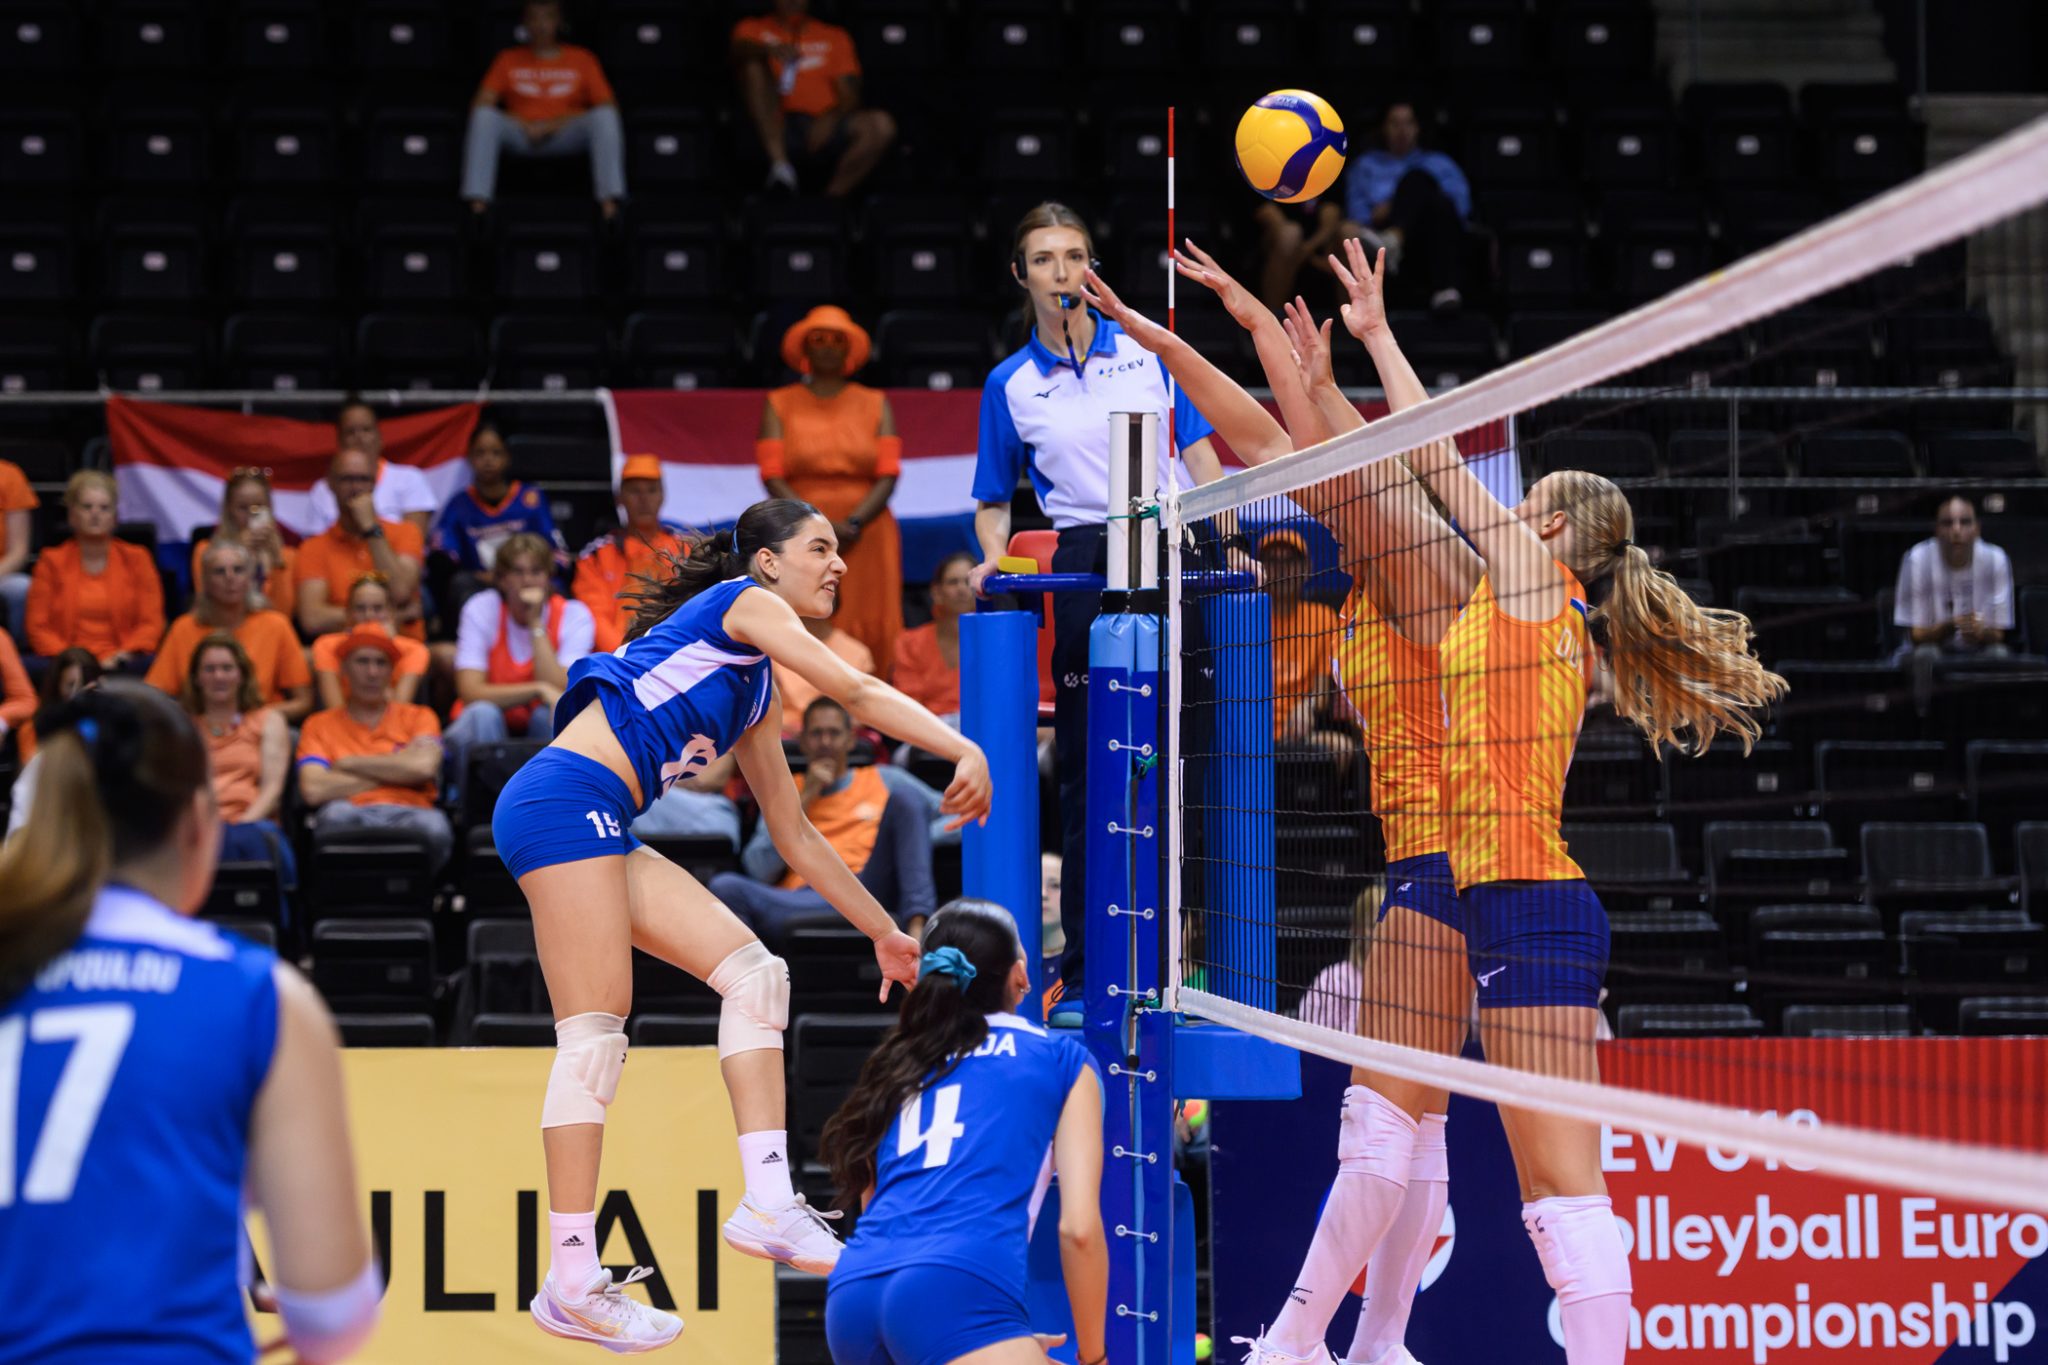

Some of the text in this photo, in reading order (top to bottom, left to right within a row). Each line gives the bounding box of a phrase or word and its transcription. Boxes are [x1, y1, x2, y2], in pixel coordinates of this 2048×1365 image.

[1117, 358, 1144, 372] CEV
[897, 1083, 965, 1169] 4
[1600, 1116, 1681, 1172] EV
[1617, 1194, 2048, 1277] lleyball Euro
